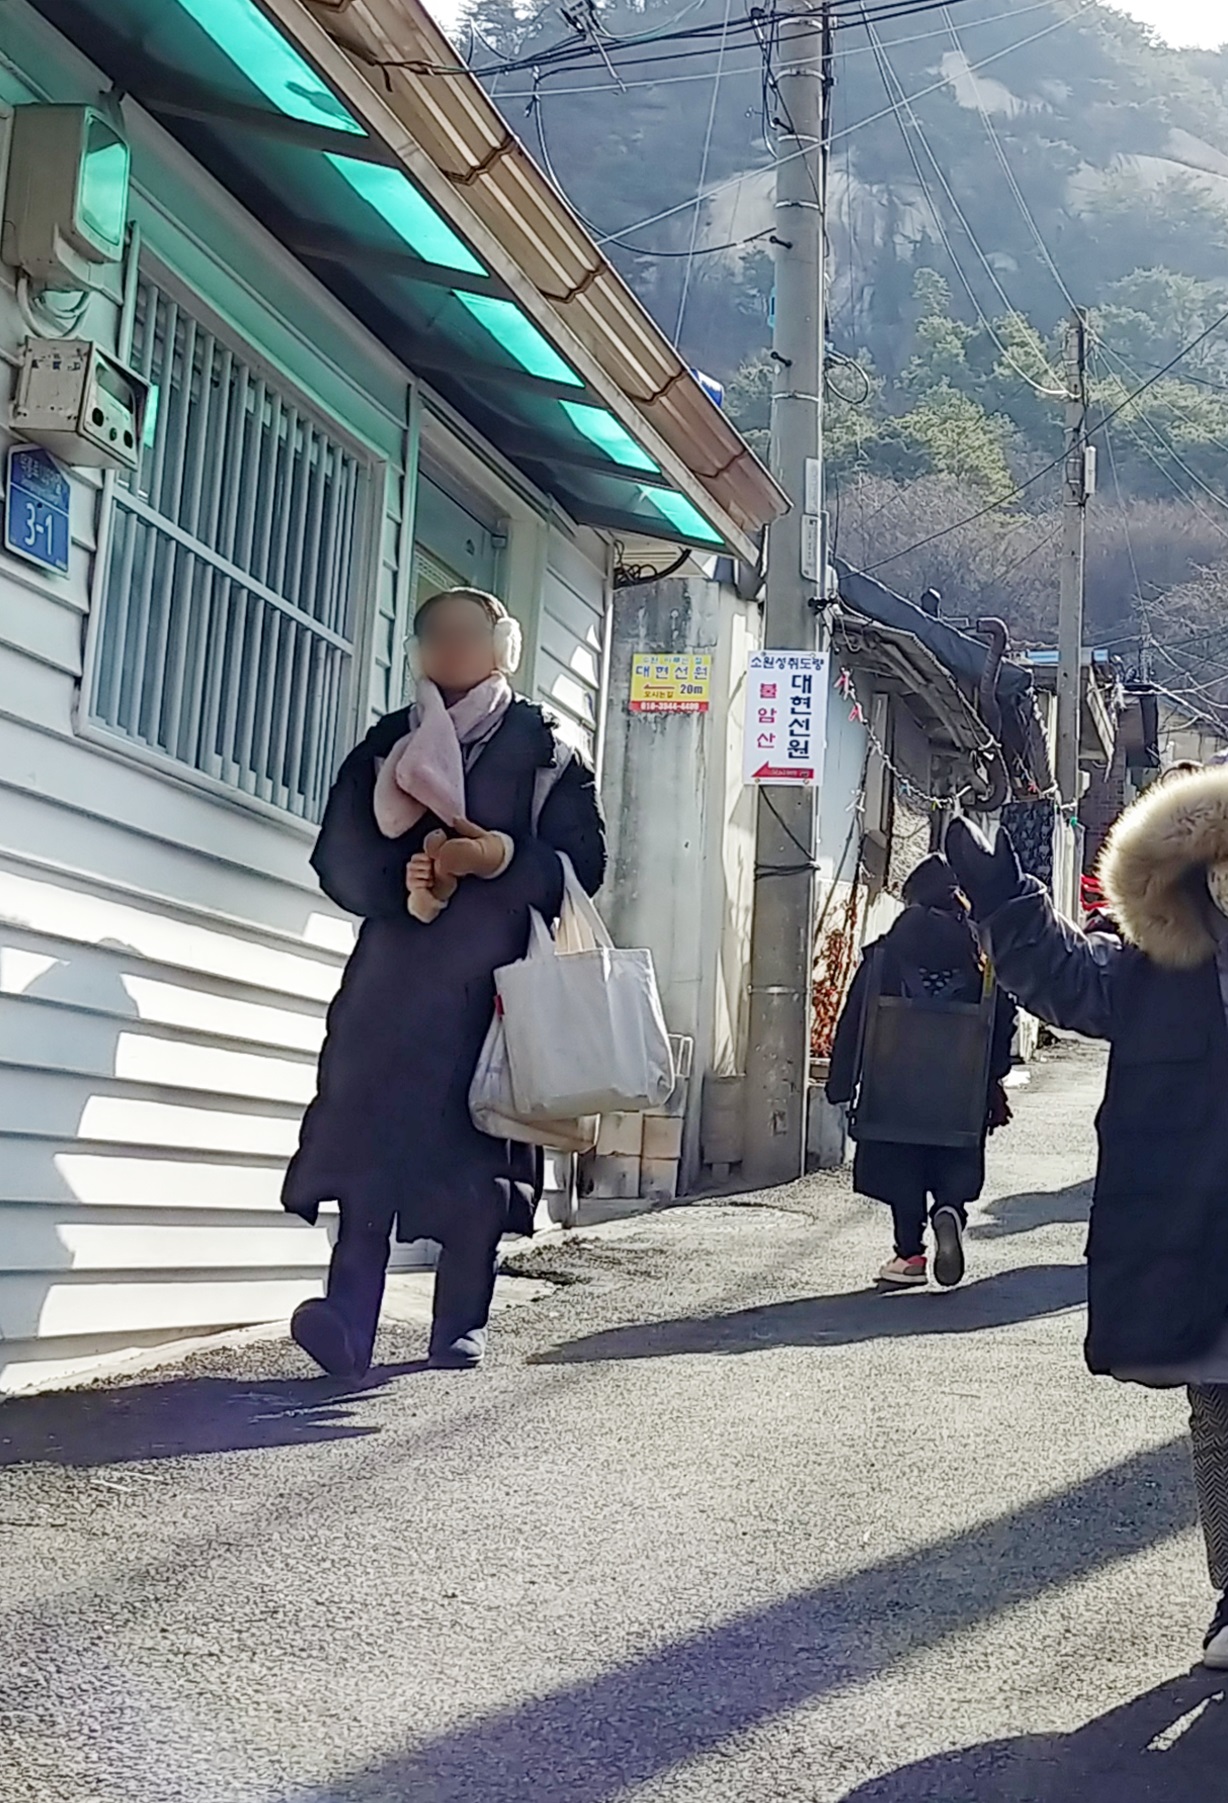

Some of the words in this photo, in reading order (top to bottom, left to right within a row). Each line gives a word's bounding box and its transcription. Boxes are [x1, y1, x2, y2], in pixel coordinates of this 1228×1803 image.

[24, 502, 54, 556] 3-1
[750, 656, 825, 671] 소원성취도량
[635, 665, 708, 680] 대현선원
[680, 683, 703, 694] 20m
[787, 674, 813, 759] 대현선원
